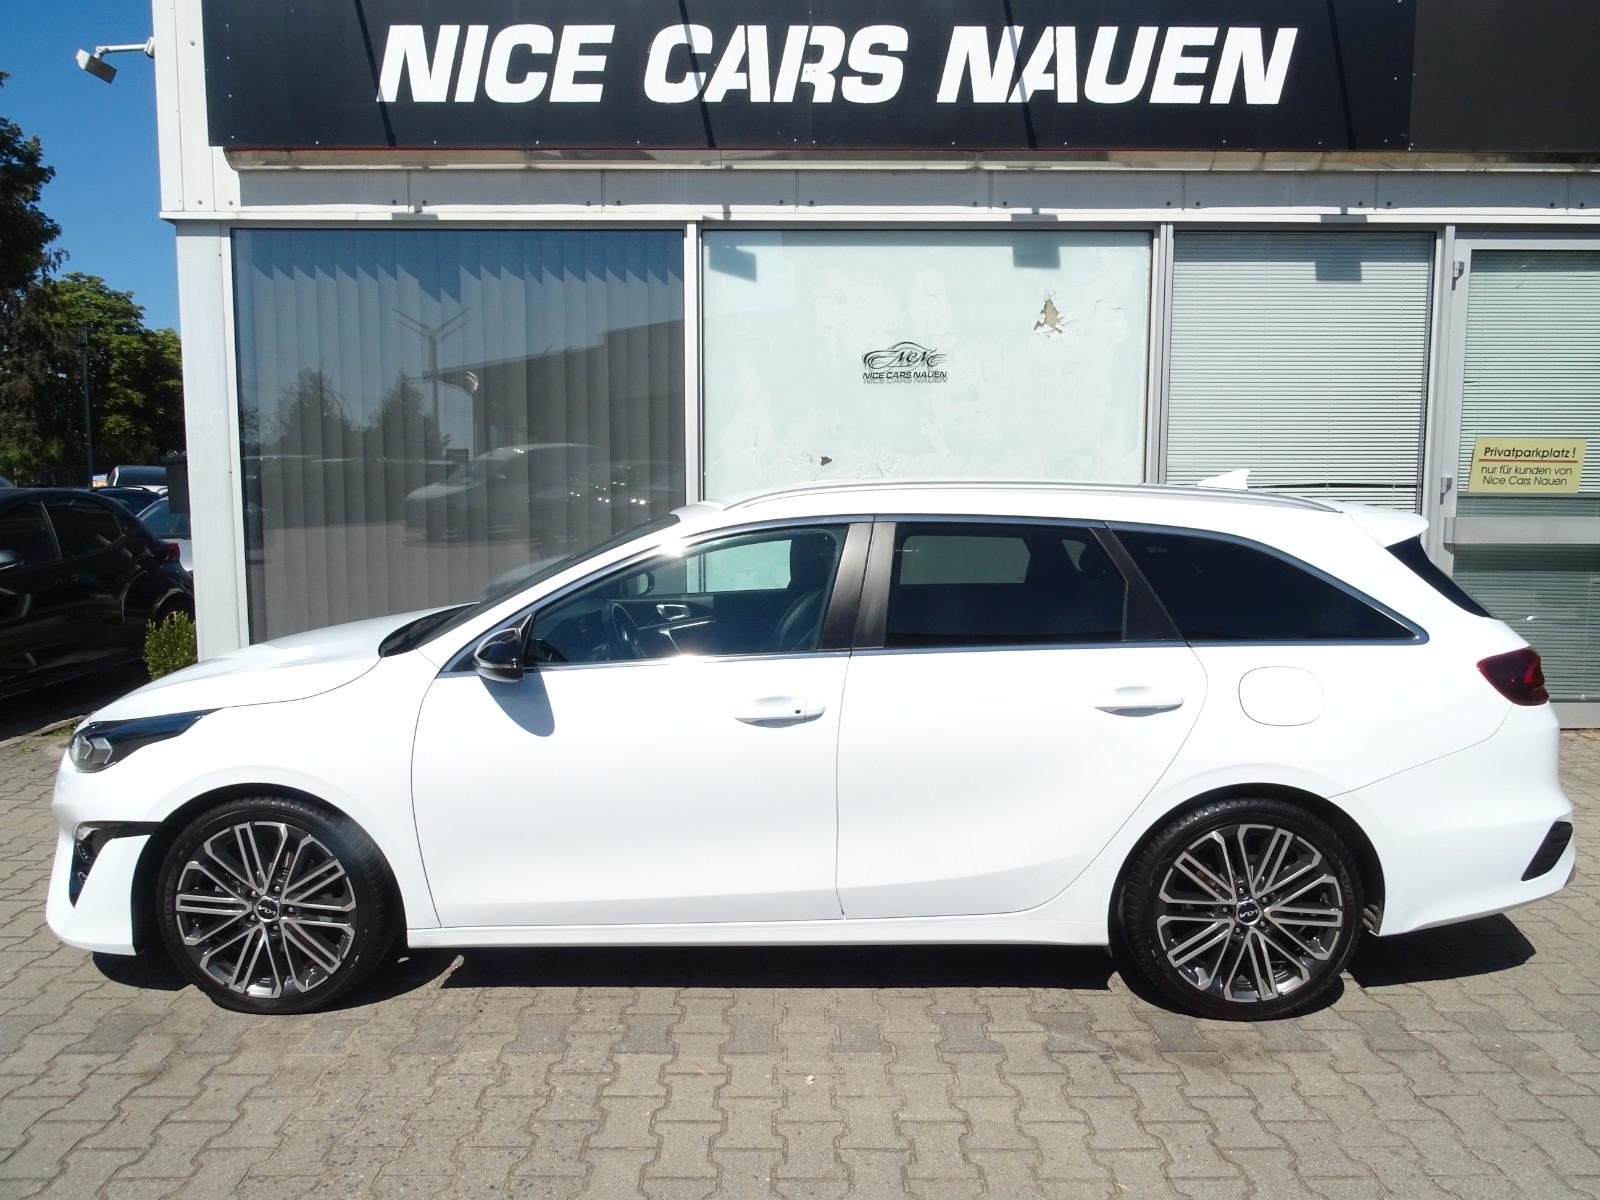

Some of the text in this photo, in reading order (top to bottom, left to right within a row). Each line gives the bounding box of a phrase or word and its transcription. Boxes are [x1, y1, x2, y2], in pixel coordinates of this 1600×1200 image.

[376, 24, 1298, 105] NICE CARS NAUEN
[863, 371, 948, 380] NICE CARS NAUEN
[1481, 464, 1573, 476] nur für kunden von
[1482, 475, 1568, 486] Nice Cars Nauen
